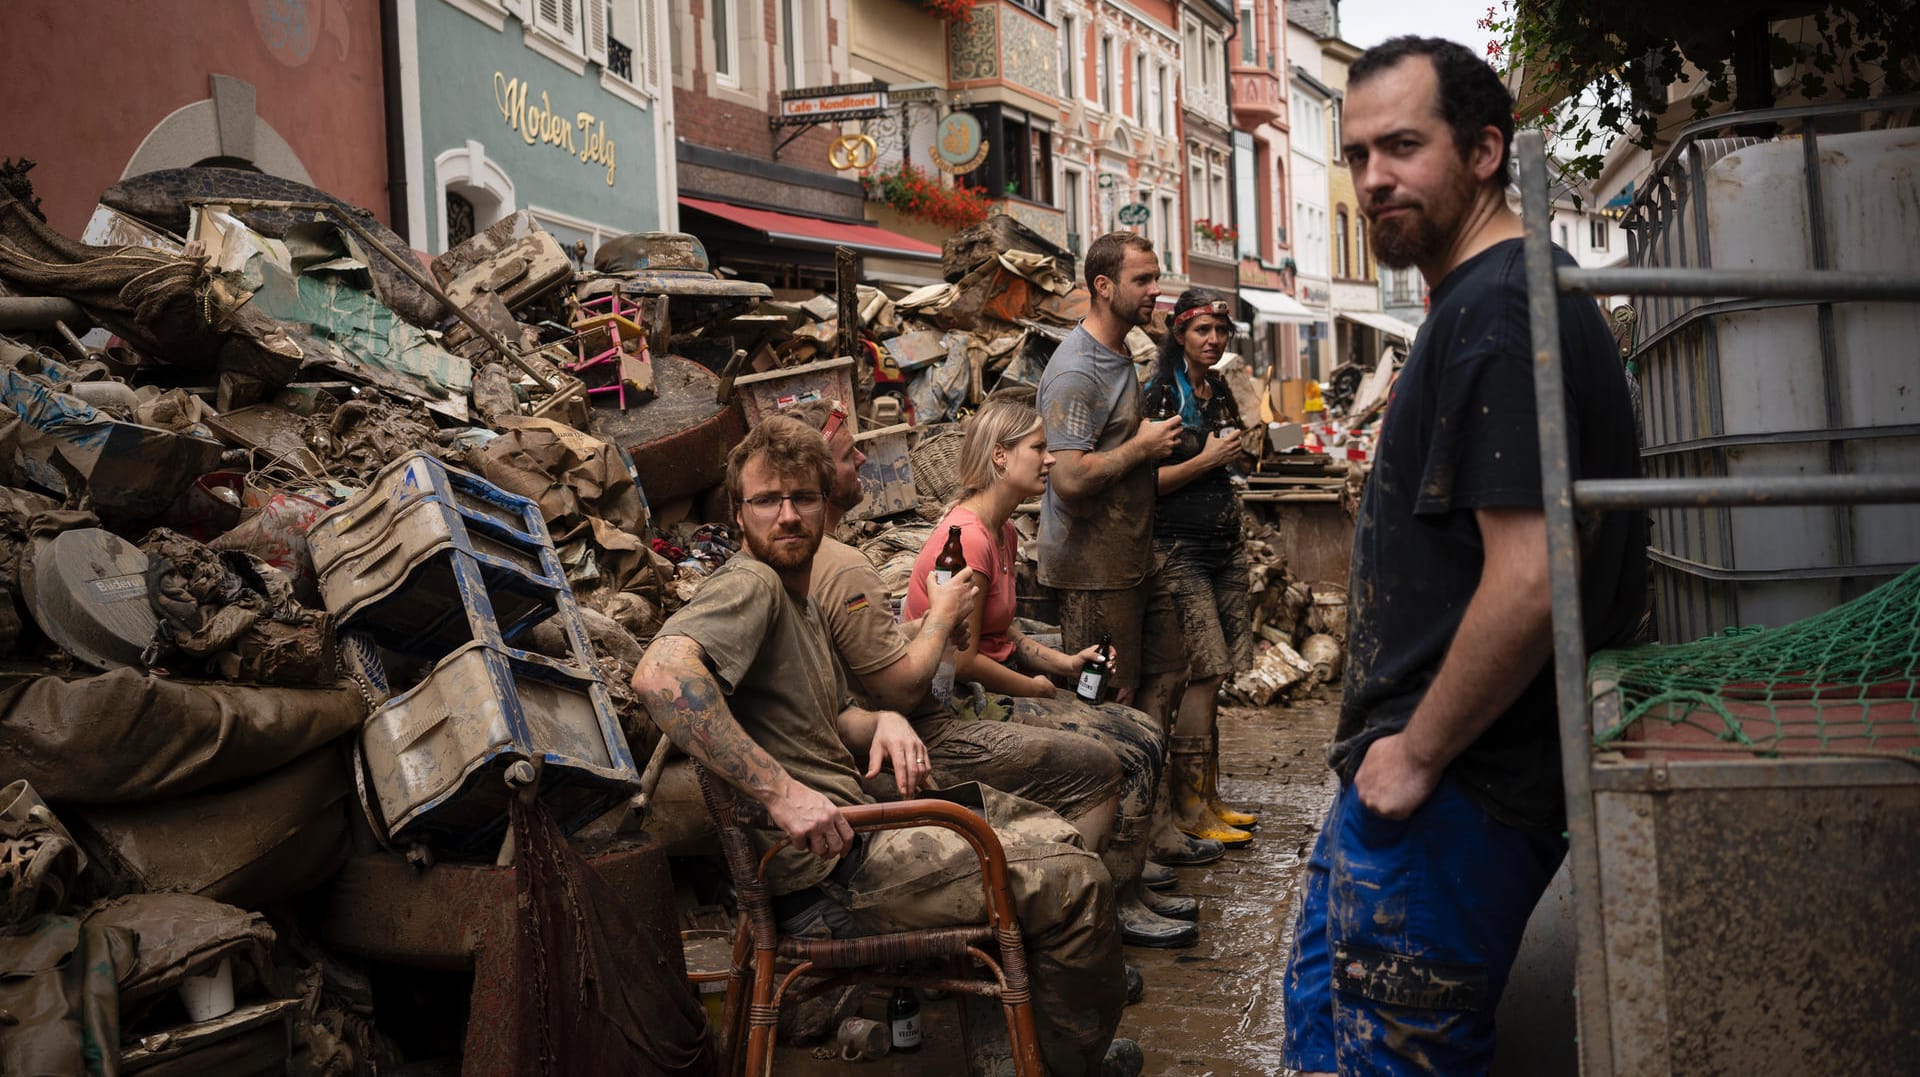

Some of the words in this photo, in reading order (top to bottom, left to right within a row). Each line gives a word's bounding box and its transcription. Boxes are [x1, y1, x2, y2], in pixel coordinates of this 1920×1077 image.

[494, 71, 576, 155] Moden
[577, 111, 617, 187] Telg
[819, 95, 876, 110] Konditorei
